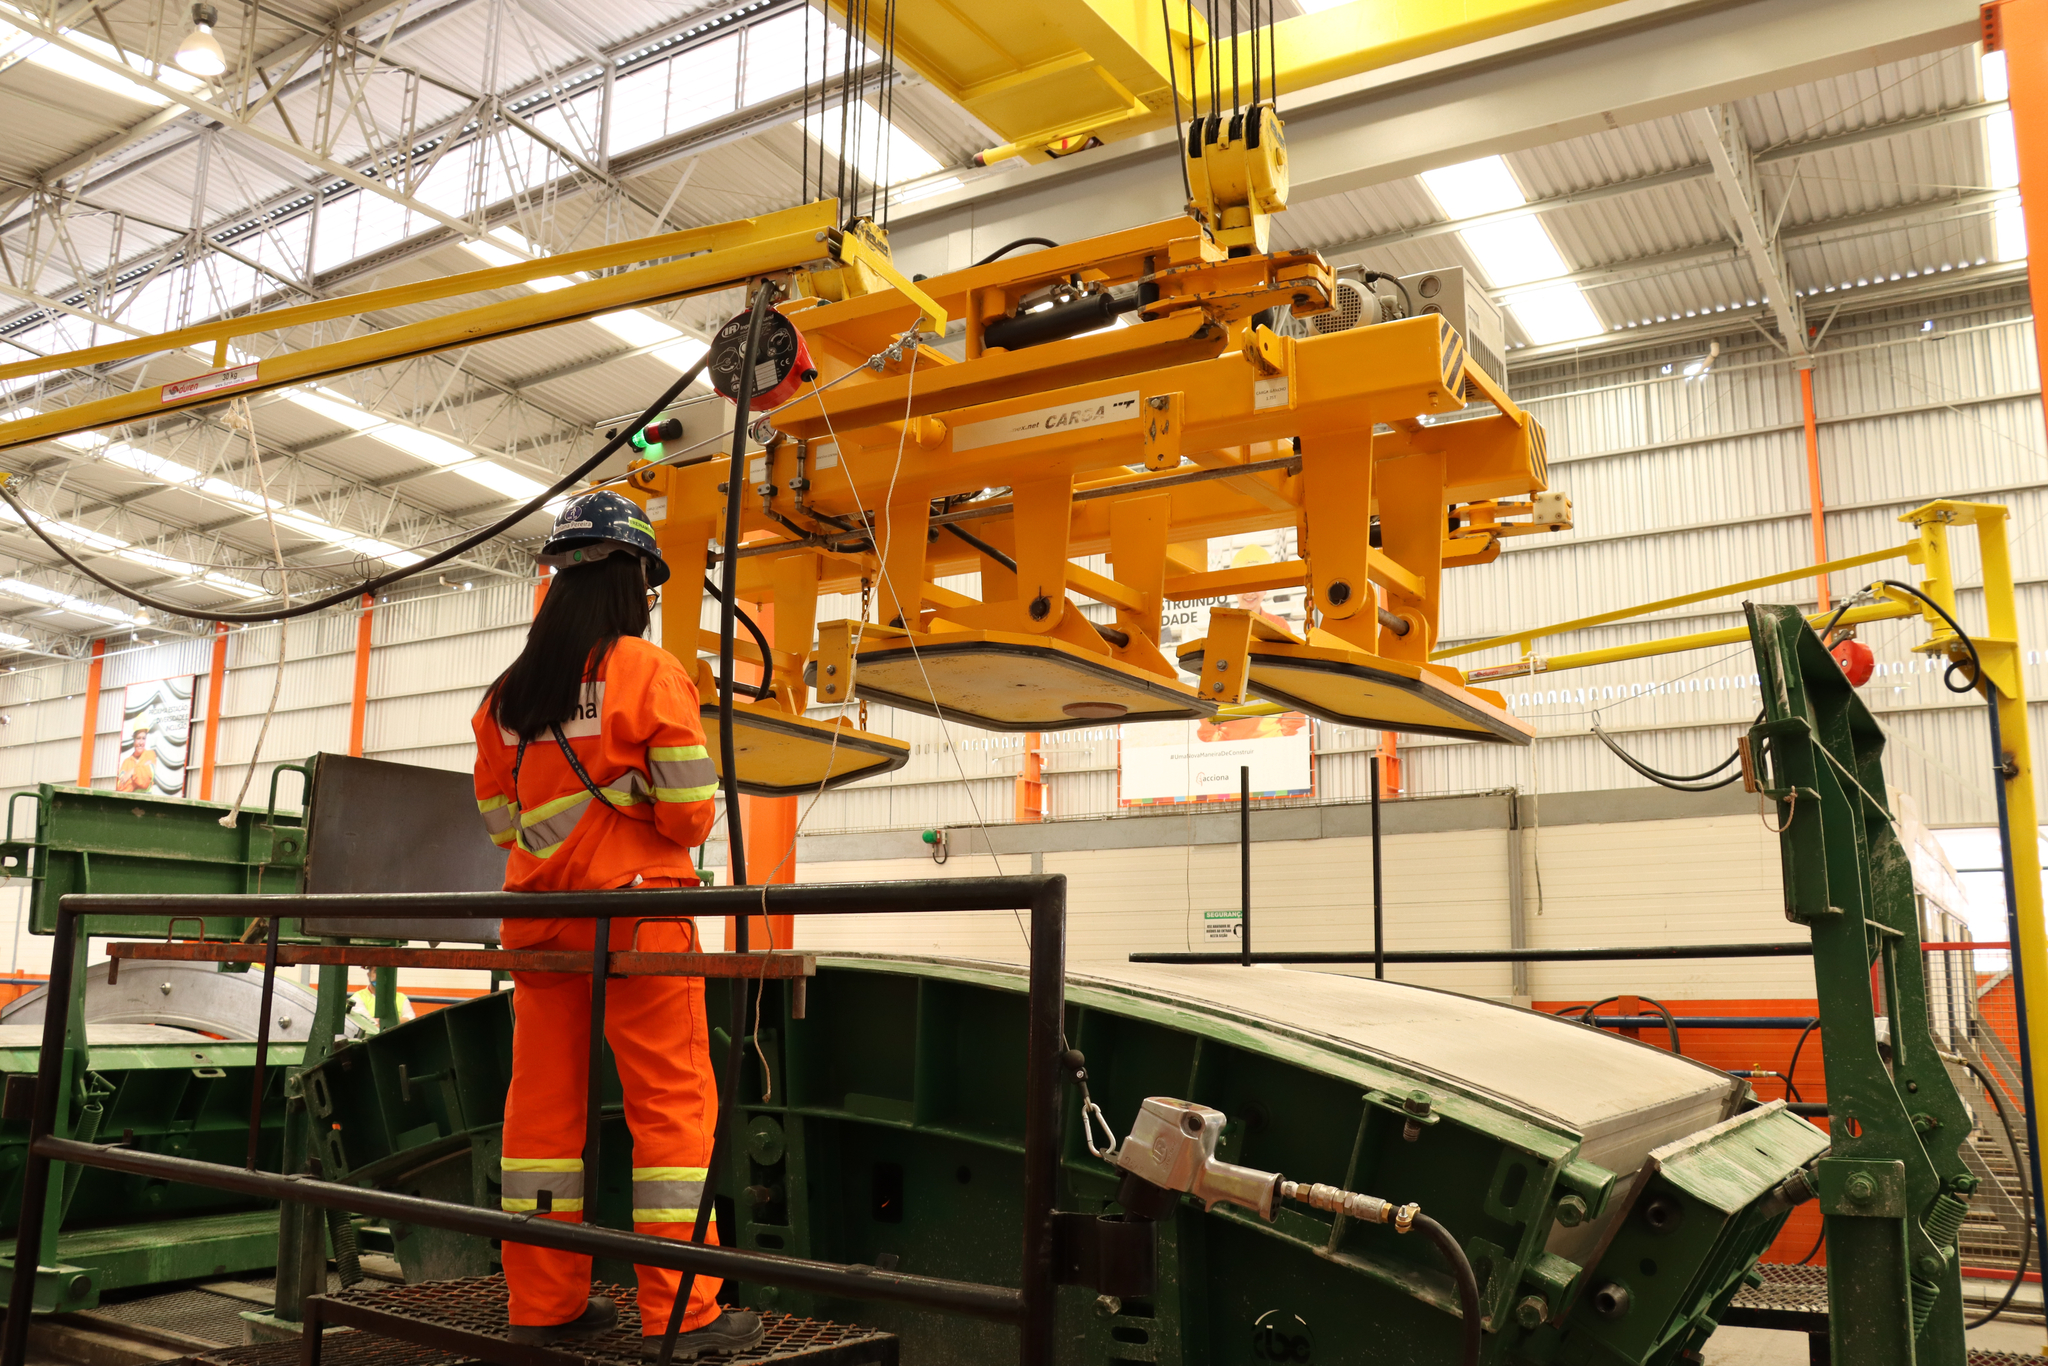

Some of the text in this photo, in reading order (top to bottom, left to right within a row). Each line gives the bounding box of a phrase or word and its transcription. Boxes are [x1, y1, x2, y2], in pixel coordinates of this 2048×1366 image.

[222, 372, 238, 381] 30 kg
[178, 383, 199, 394] duren
[564, 747, 577, 764] IMET
[1170, 748, 1254, 760] #UmaNovaManeiraDeConstruir
[1202, 774, 1229, 782] acciona
